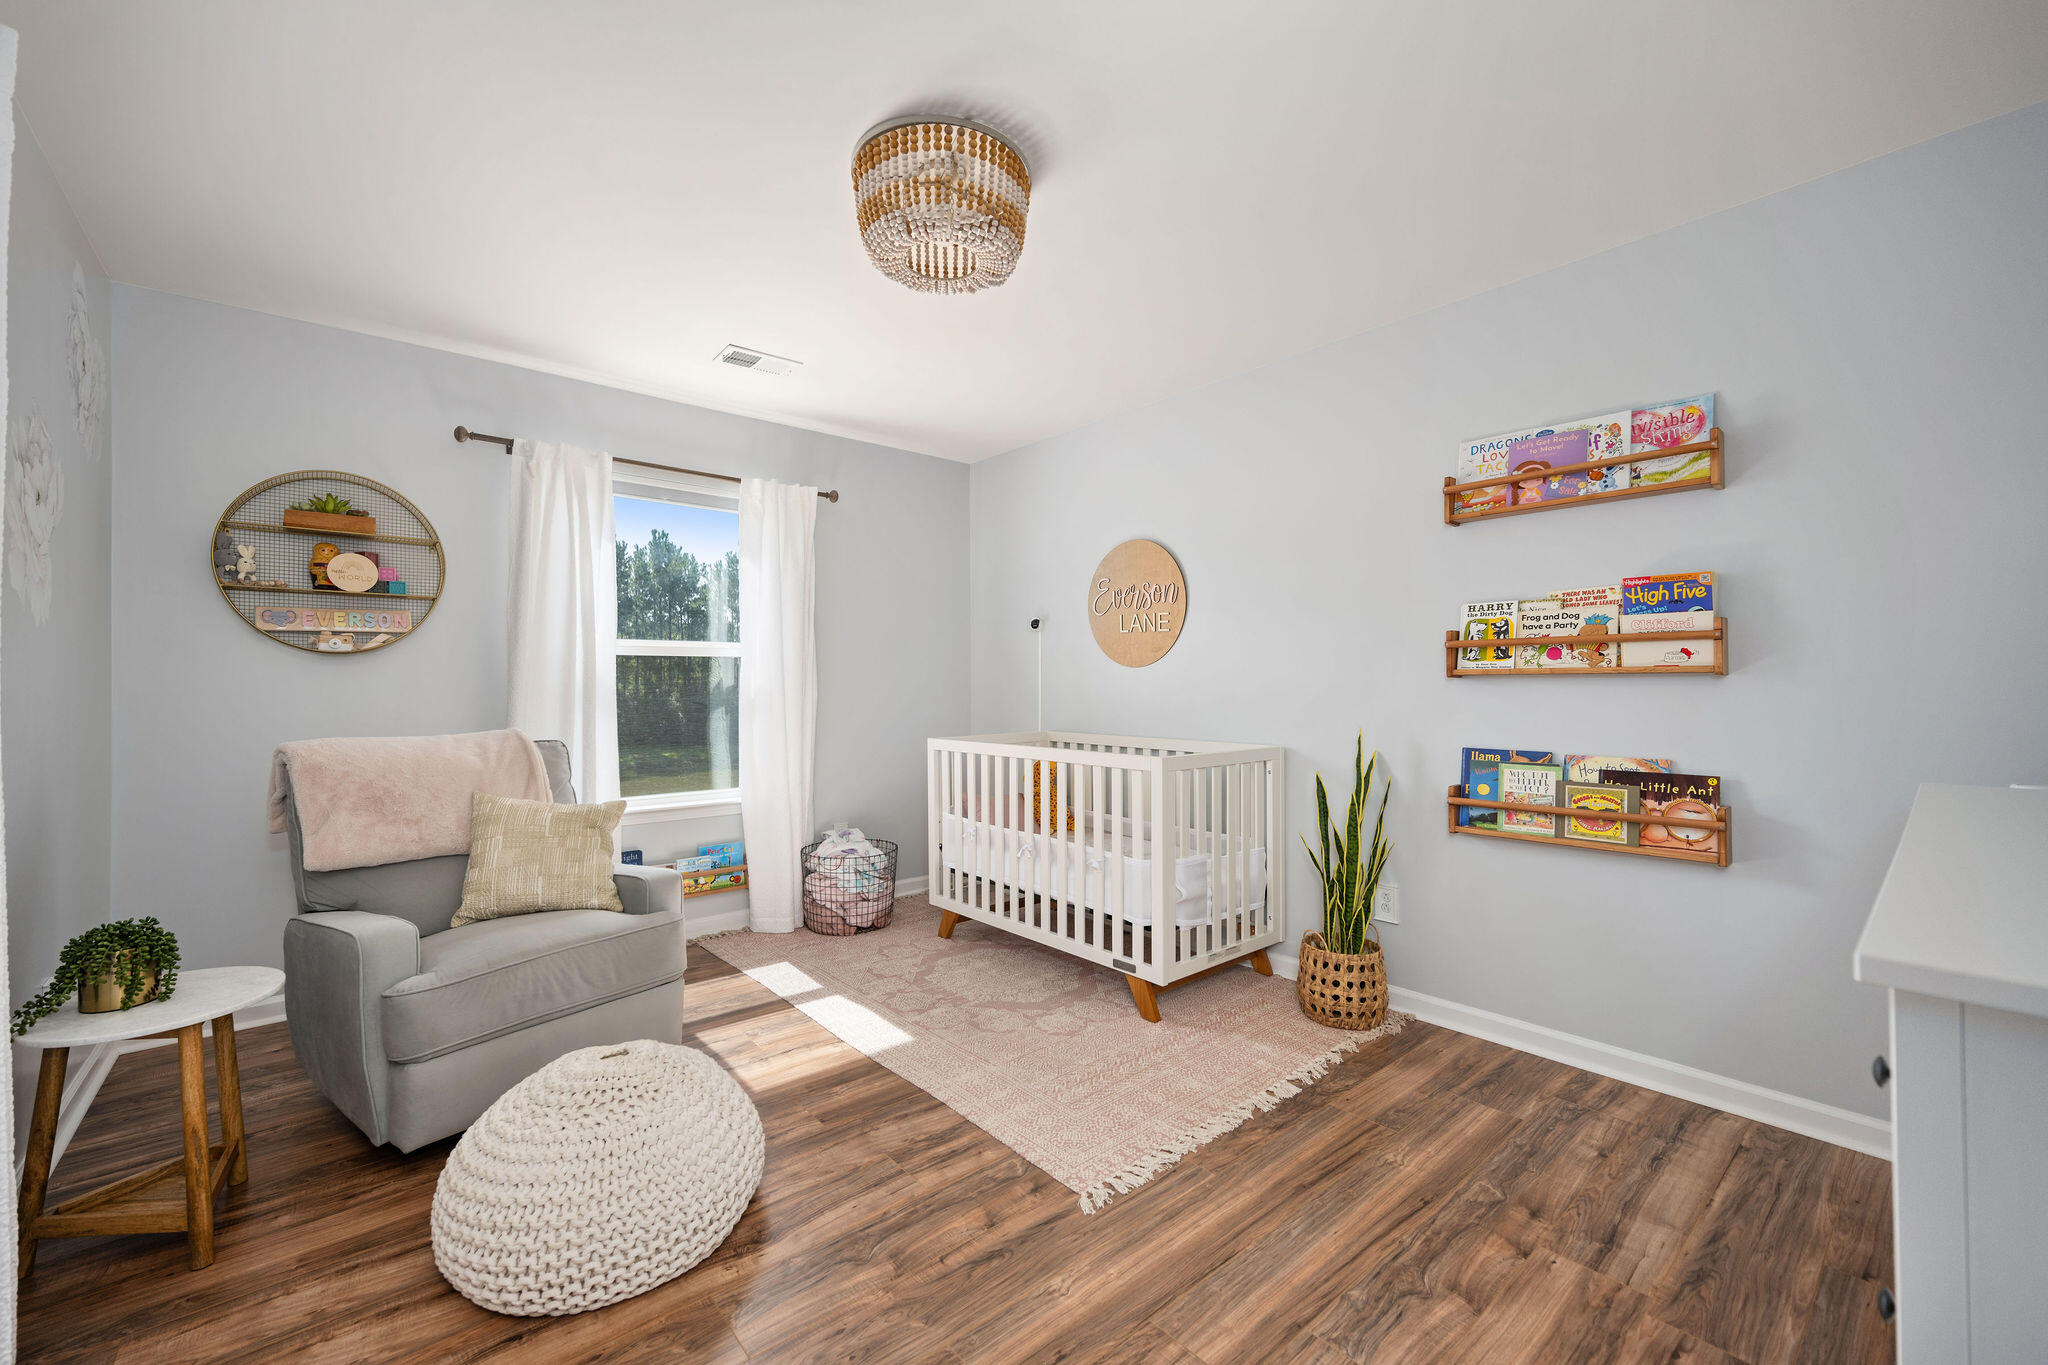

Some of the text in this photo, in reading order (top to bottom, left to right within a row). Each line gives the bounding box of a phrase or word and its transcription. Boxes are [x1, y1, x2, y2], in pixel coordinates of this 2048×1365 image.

[1482, 450, 1509, 463] LOV
[338, 574, 374, 583] WORLD
[1093, 577, 1180, 616] Everson
[1625, 581, 1707, 606] High Five
[1468, 602, 1514, 613] HARRY
[1627, 604, 1647, 614] Let's
[301, 609, 409, 629] EVERSON
[1119, 611, 1171, 633] LANE
[1521, 612, 1580, 623] Frog and Dog
[1522, 622, 1544, 630] have
[1553, 621, 1579, 630] Party
[1630, 616, 1696, 632] Clifford
[1471, 750, 1501, 762] llama
[1640, 781, 1680, 794] Little
[1686, 785, 1715, 797] Ant
[622, 853, 639, 863] ight
